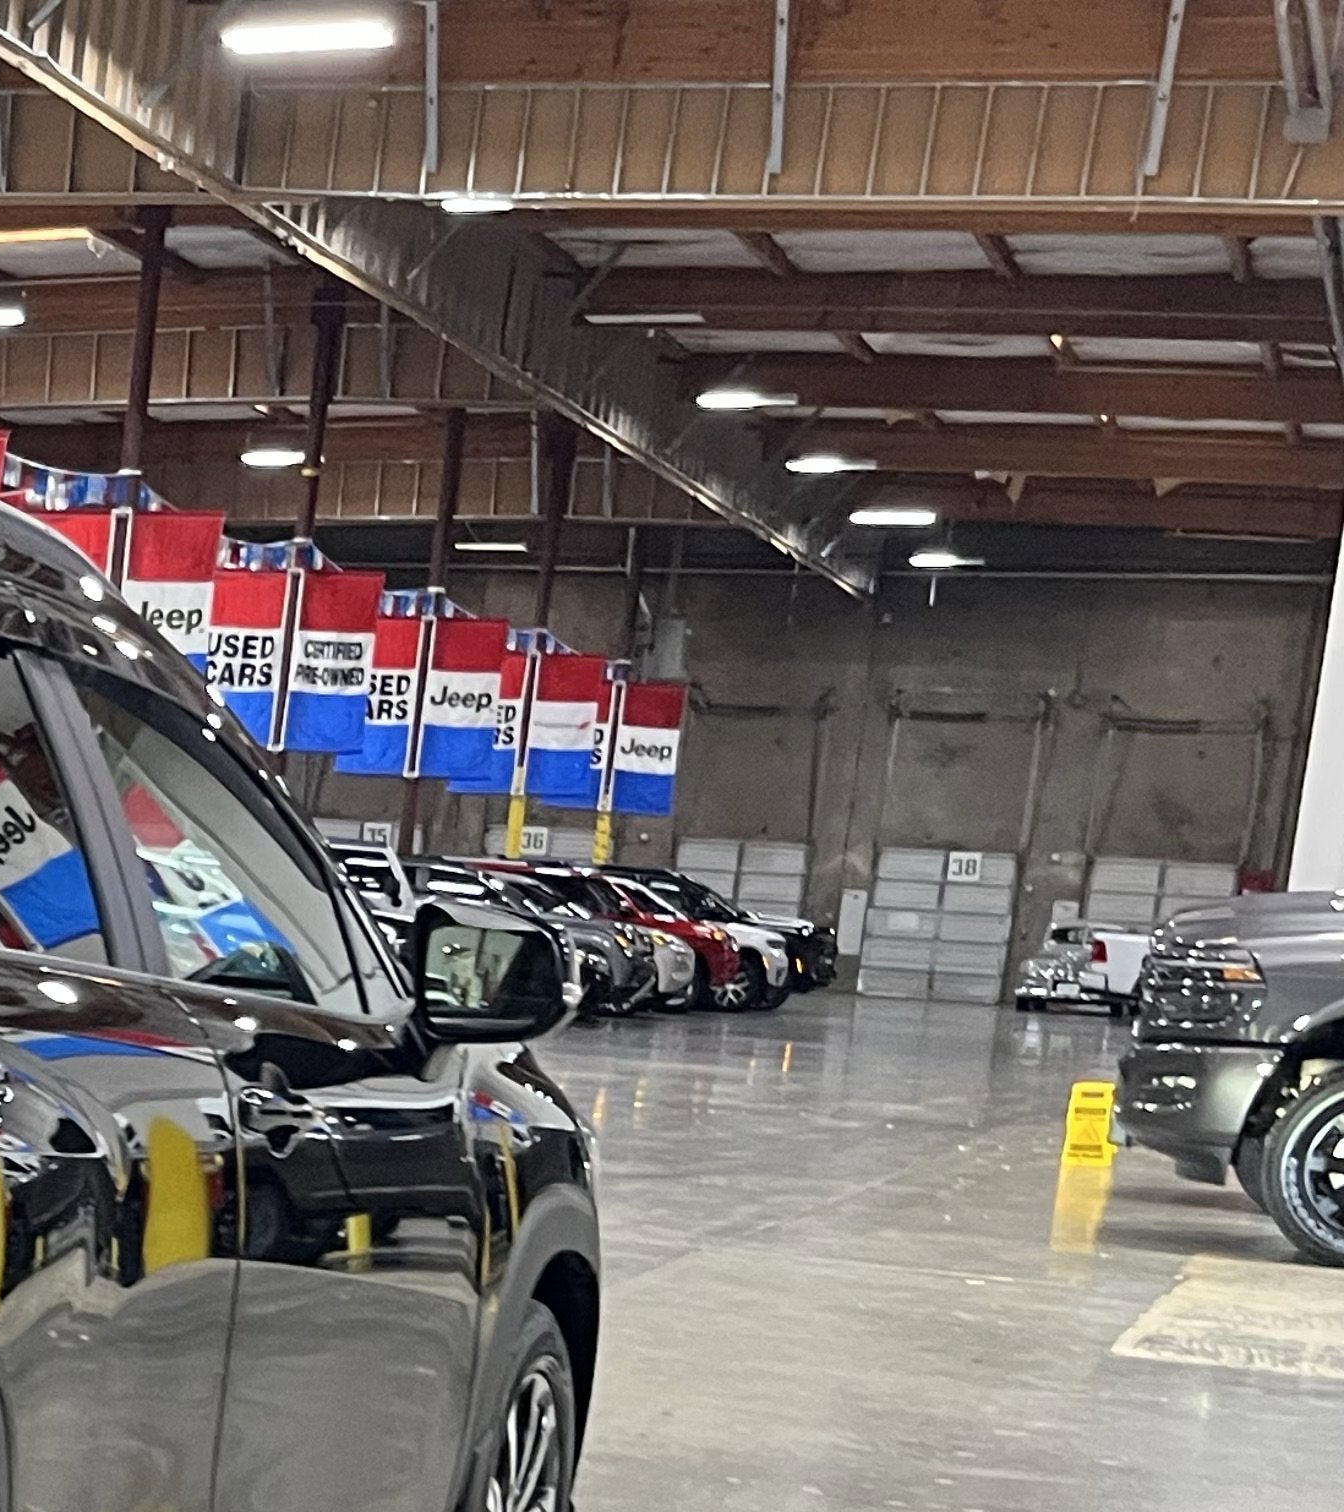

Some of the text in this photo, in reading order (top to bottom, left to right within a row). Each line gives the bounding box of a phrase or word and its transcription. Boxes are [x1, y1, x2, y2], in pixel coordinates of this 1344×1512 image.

[208, 632, 275, 660] USED
[205, 660, 273, 687] CARS
[430, 685, 492, 713] Jeep
[620, 738, 673, 762] Jeep
[951, 858, 978, 876] 38
